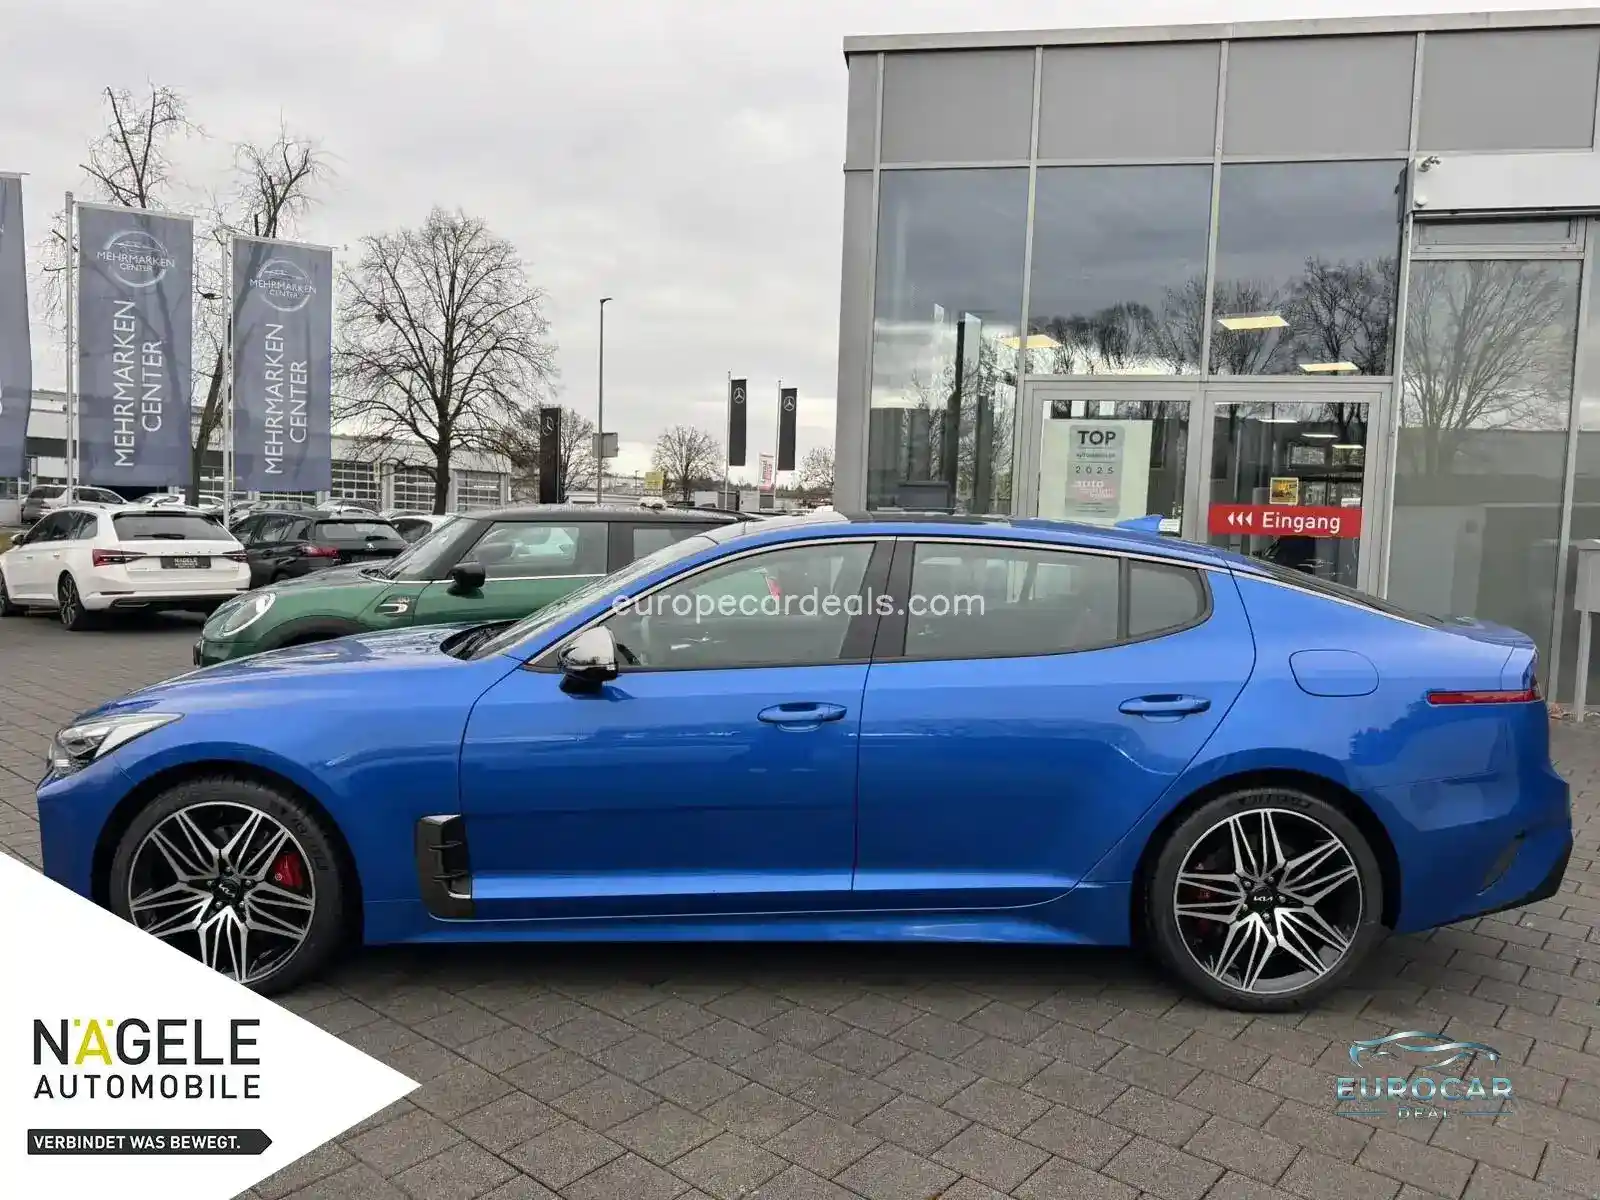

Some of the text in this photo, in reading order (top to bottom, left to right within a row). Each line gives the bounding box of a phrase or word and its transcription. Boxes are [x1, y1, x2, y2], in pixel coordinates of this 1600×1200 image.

[97, 251, 175, 268] MEHRMARKEN
[114, 300, 136, 467] MEHRMARKEN
[142, 340, 163, 431] CENTER
[265, 323, 284, 474] MEHRMARKEN
[290, 360, 308, 443] CENTER
[1077, 430, 1116, 445] TOP
[1262, 511, 1341, 534] Eingang
